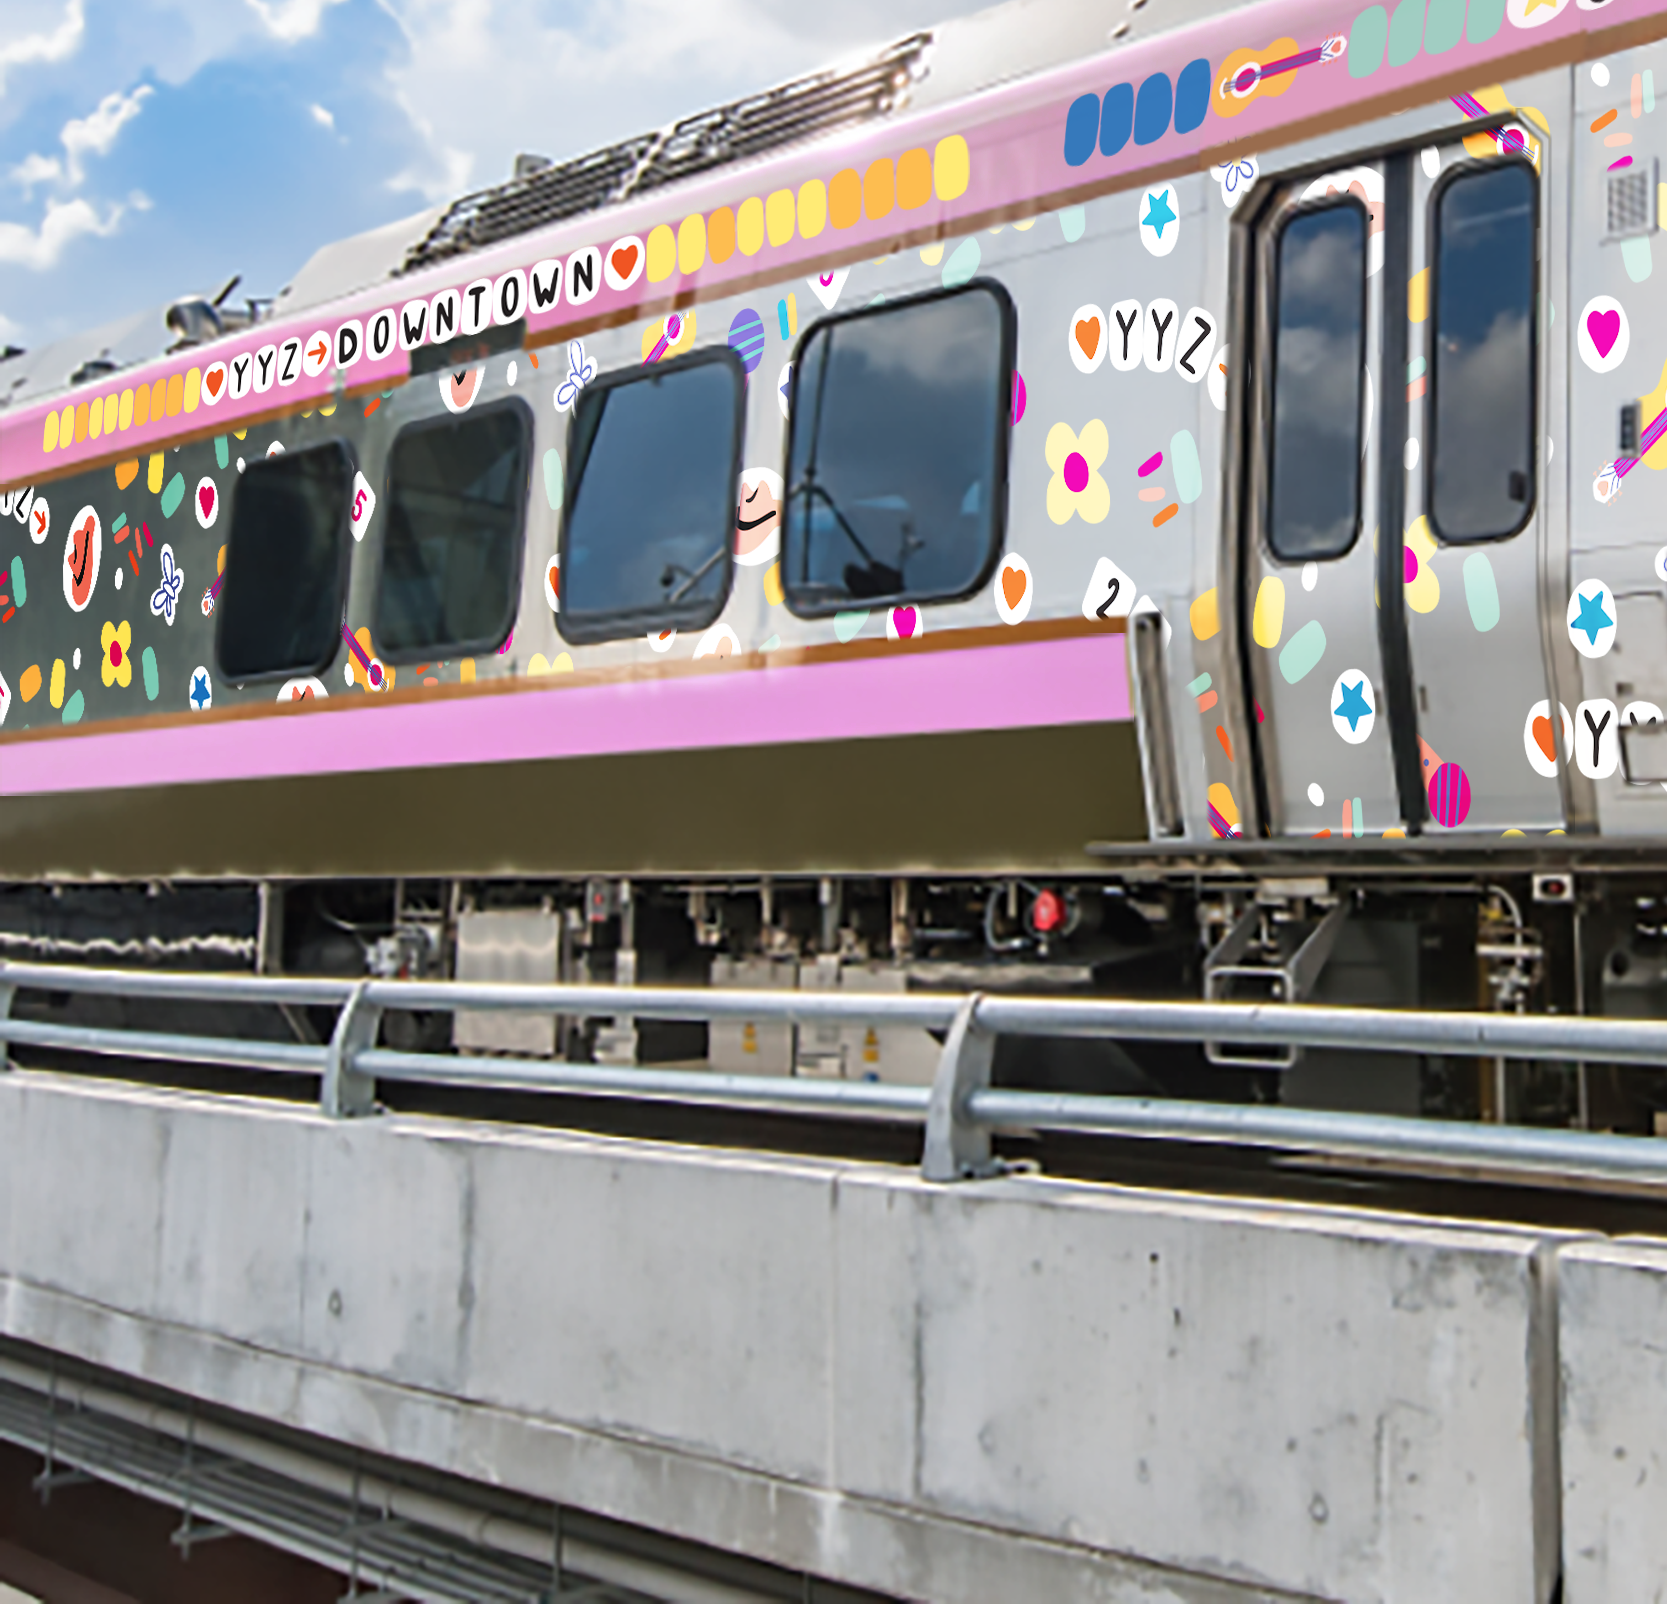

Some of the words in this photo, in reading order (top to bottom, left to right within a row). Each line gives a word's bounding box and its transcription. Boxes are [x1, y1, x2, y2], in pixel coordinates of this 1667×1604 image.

[233, 342, 298, 393] YYZ
[338, 254, 593, 364] DOWNTOWN
[1115, 308, 1212, 375] YYZ
